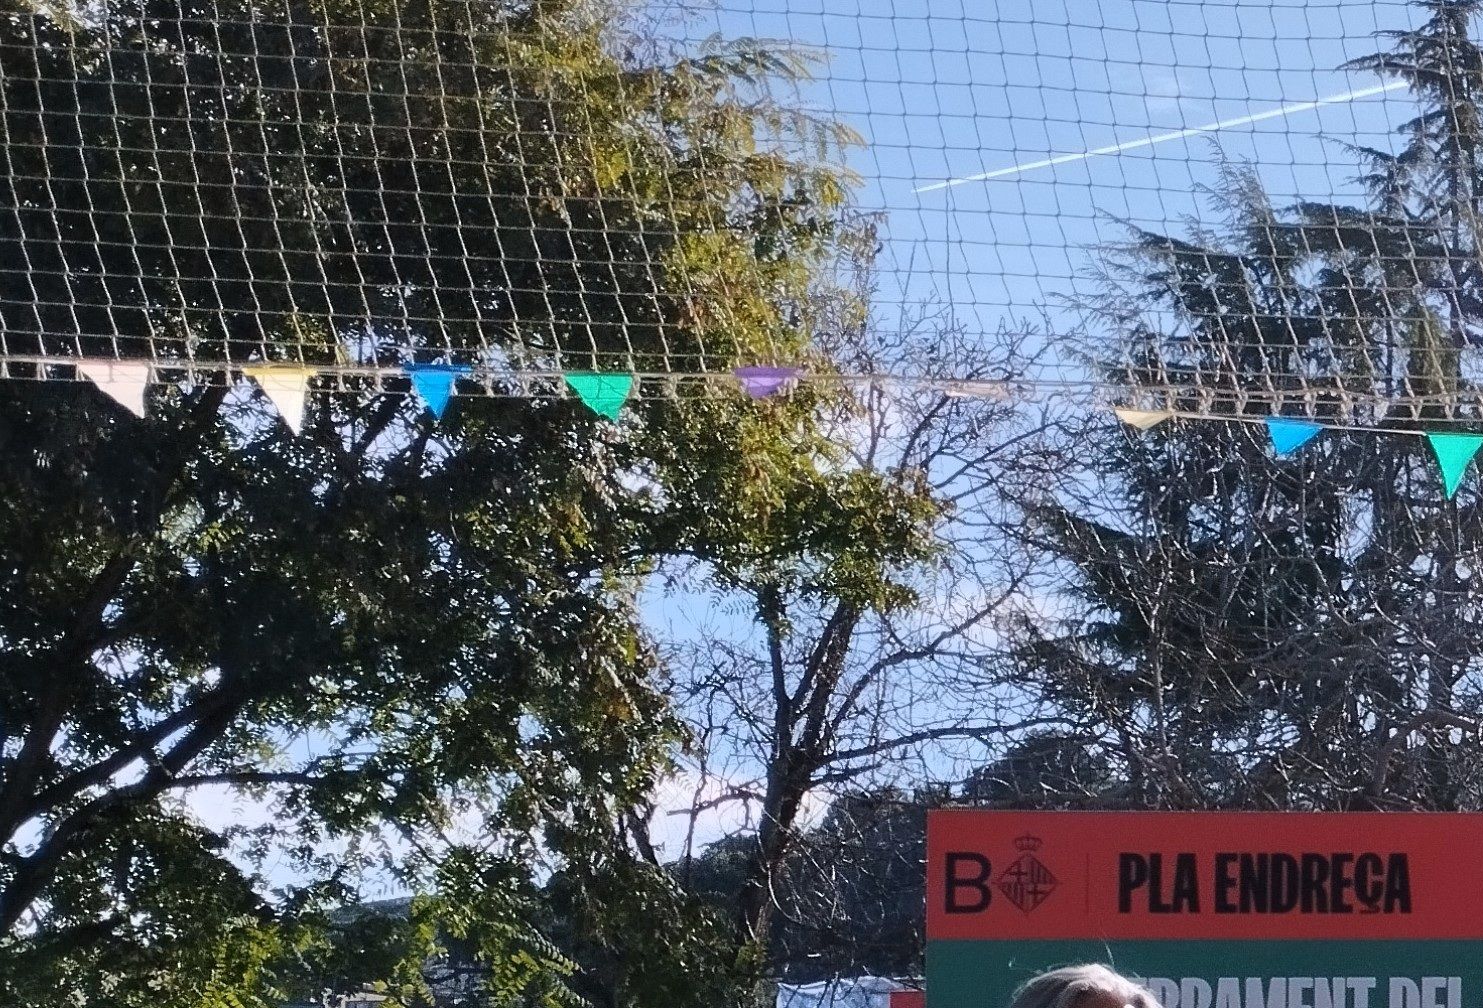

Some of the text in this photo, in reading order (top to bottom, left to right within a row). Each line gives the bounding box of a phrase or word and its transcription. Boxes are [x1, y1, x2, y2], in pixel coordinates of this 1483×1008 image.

[945, 852, 992, 914] B
[1119, 852, 1412, 916] PLA ENDREÇA
